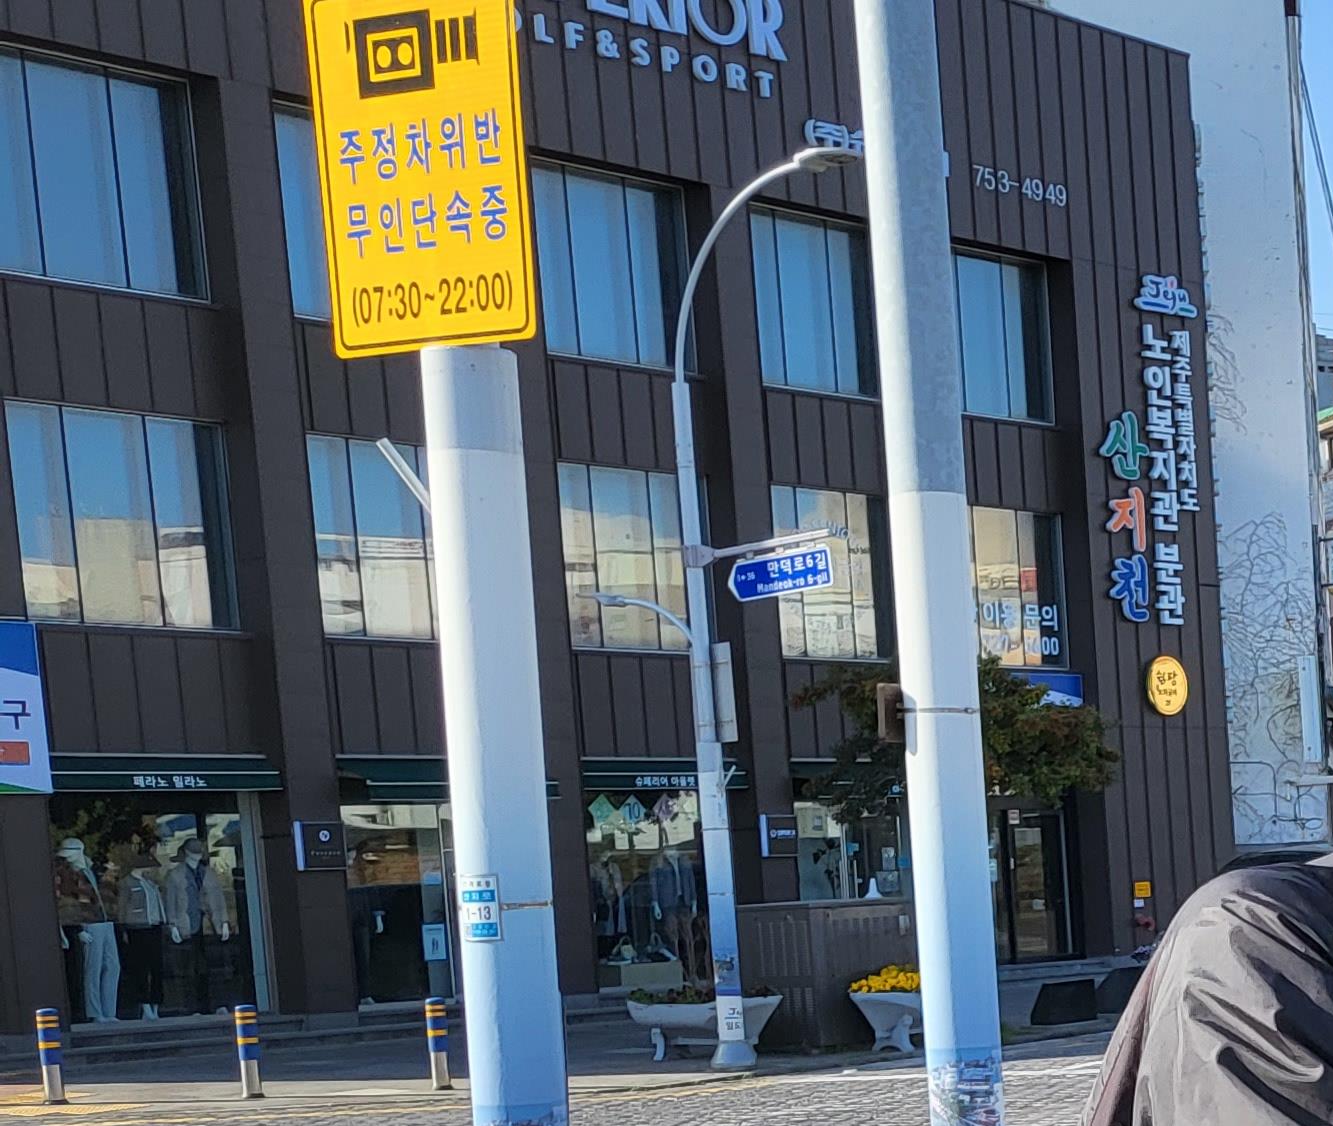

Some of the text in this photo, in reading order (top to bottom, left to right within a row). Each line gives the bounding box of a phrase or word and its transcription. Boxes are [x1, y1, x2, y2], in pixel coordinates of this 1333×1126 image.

[515, 8, 775, 98] LF&SPORT
[339, 107, 501, 185] 주정차위반
[972, 164, 1067, 207] 753-4949
[347, 184, 507, 259] 무인단속중
[352, 270, 513, 328] (07:30~22:00)
[1170, 330, 1201, 512] 제주특별자치도
[1141, 323, 1186, 626] 노인복지관 분관
[1100, 410, 1151, 622] 산지천
[766, 552, 827, 578] 만덕로6길
[1023, 604, 1059, 631] 문의
[133, 776, 207, 788] 페라노 밀라노
[635, 776, 696, 787] 슈페리어 아울렛
[466, 905, 492, 921] 1-13
